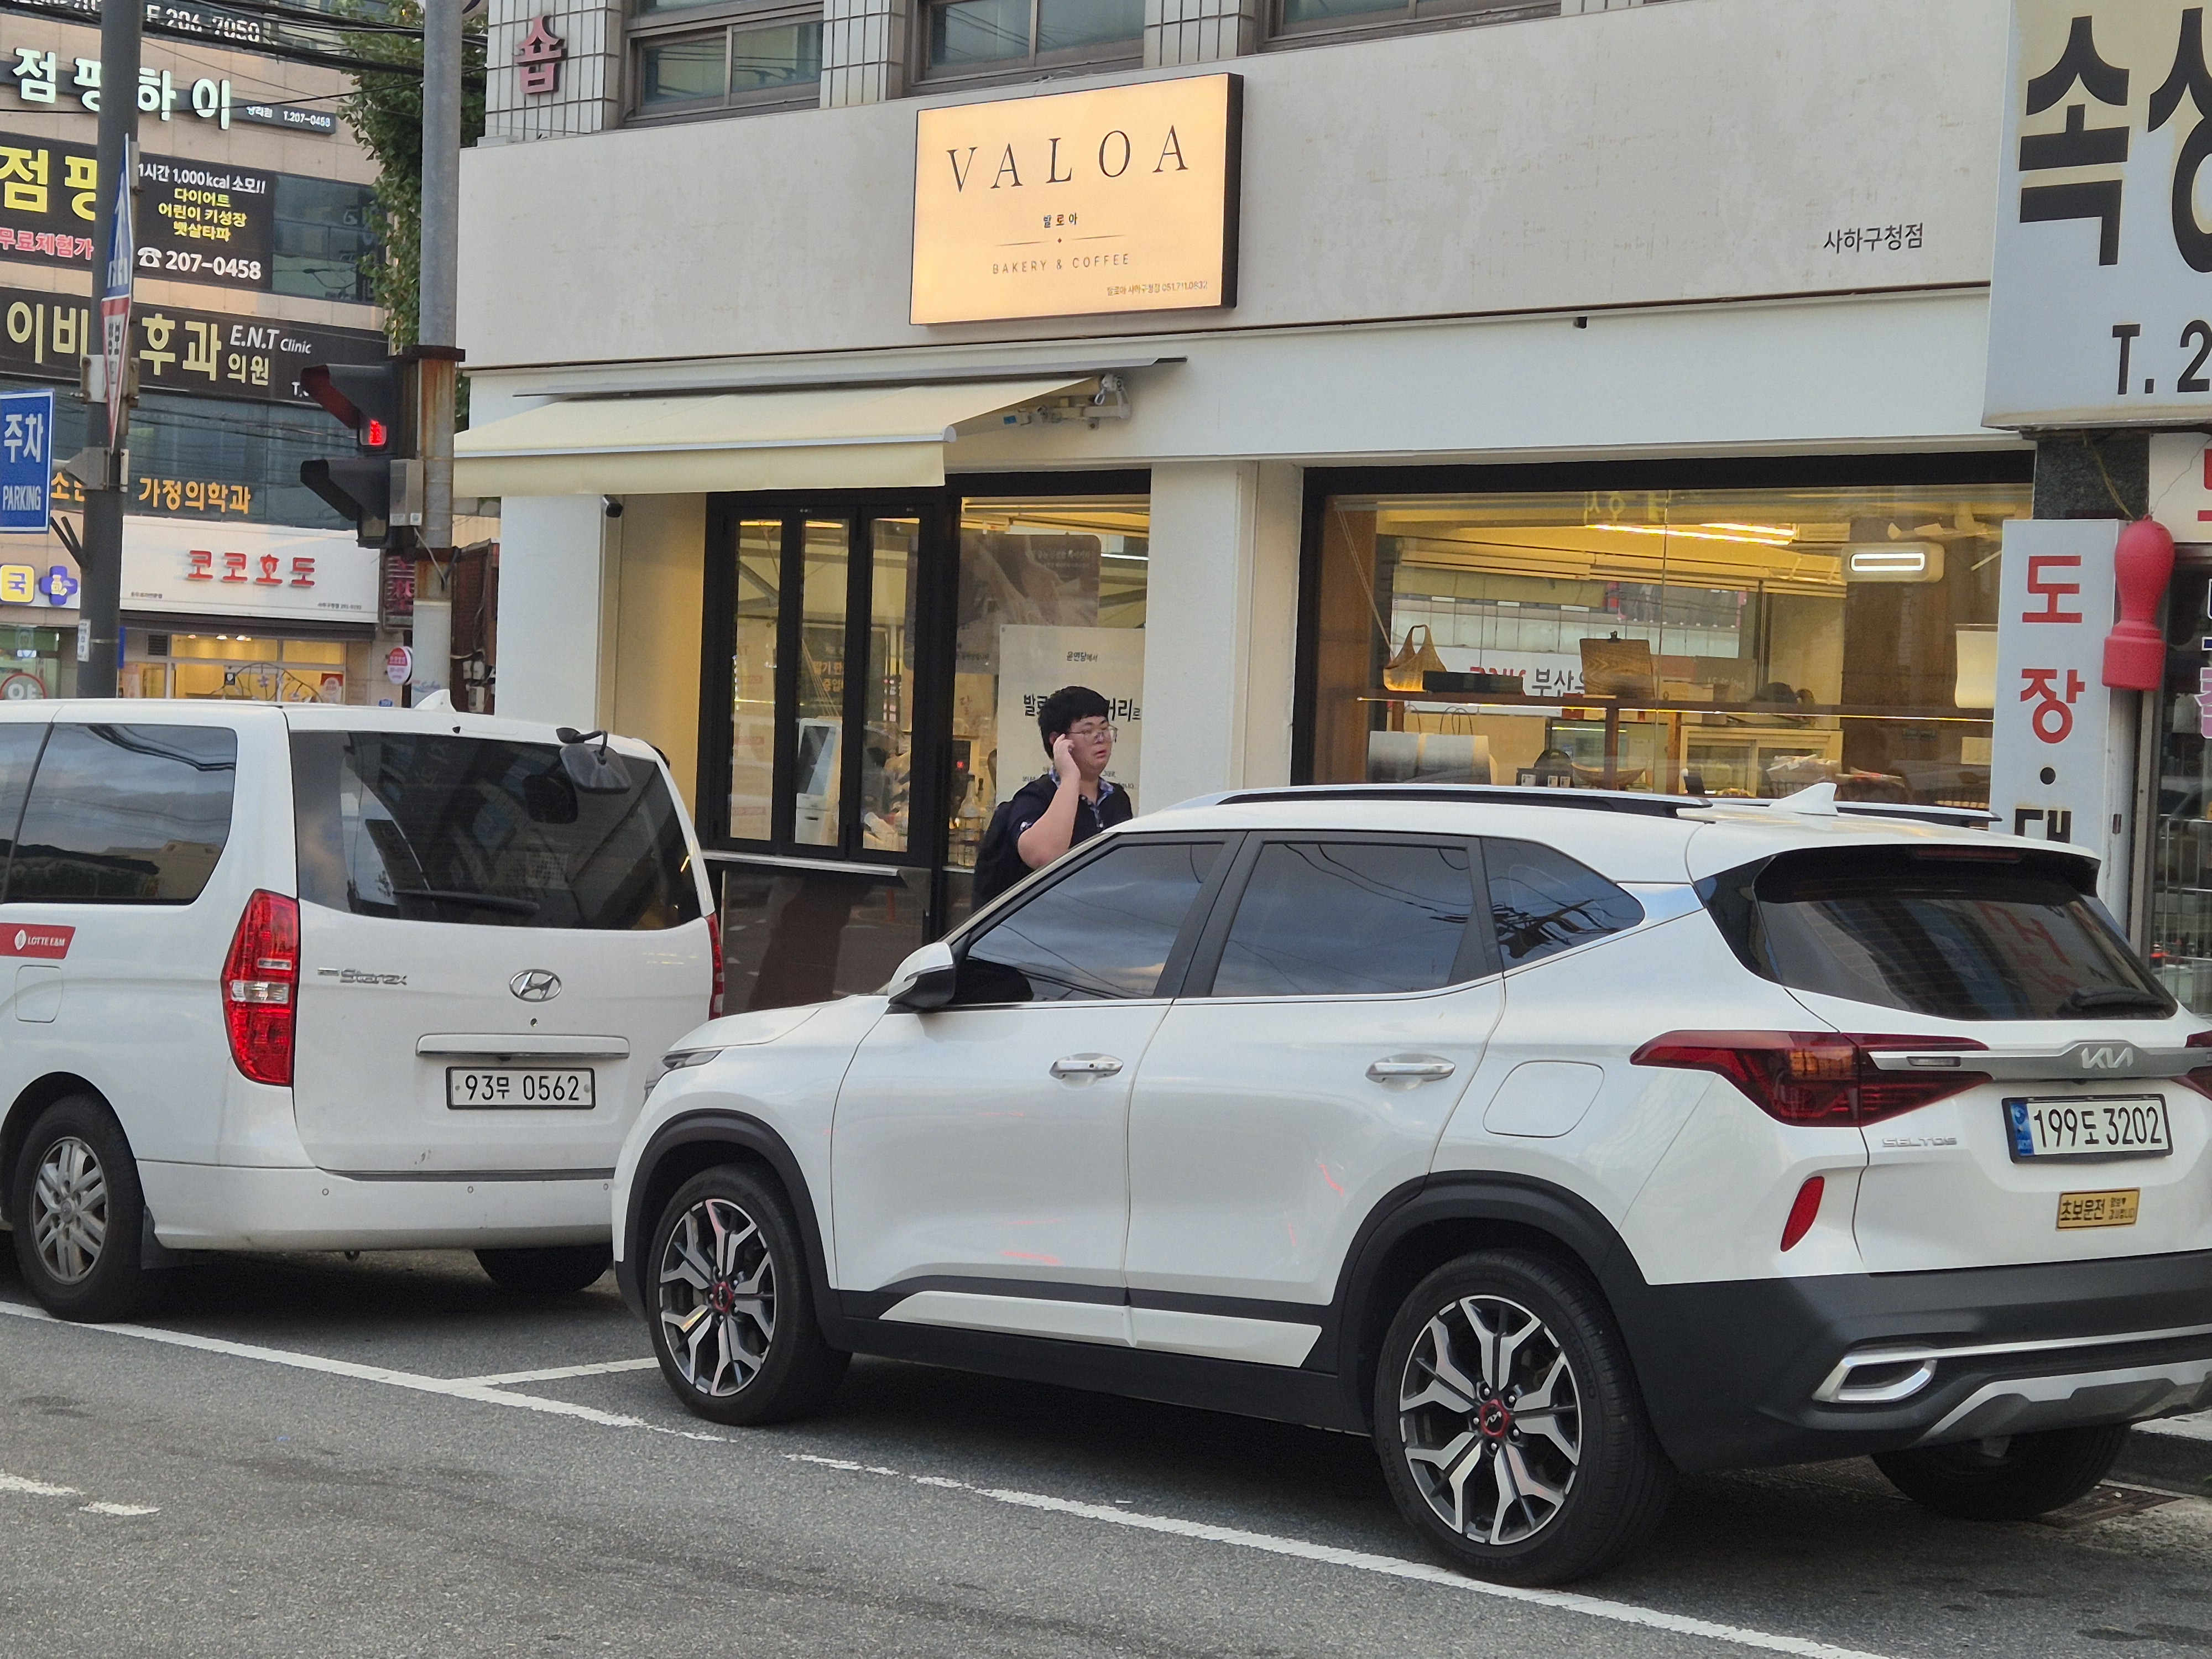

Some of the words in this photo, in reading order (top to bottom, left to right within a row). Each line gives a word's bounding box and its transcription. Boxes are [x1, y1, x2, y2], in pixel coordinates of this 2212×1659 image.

[514, 15, 562, 94] 숍
[946, 125, 1188, 192] VALOA
[138, 163, 169, 182] 1시간
[174, 188, 231, 208] 다이어트
[158, 202, 201, 222] 어린이
[205, 209, 248, 228] 키성장
[1823, 222, 1923, 254] 사하구청점
[165, 251, 262, 280] 207-0458
[993, 259, 1047, 275] BAKERY
[1056, 258, 1062, 270] &
[1072, 253, 1130, 269] COFFEE
[229, 325, 280, 350] E.N.T
[280, 338, 312, 354] Clinic
[227, 353, 269, 386] 의원
[4, 414, 43, 463] 주차
[3, 484, 41, 511] PARKING
[138, 477, 252, 515] 가정의학과
[187, 550, 316, 586] 코코호도
[28, 936, 49, 946] LOTTE
[340, 969, 407, 985] Starex
[464, 1074, 510, 1101] 93무
[523, 1074, 580, 1101] 0562
[1882, 1136, 1957, 1148] SELTOS
[2060, 1198, 2106, 1221] 초보운전
